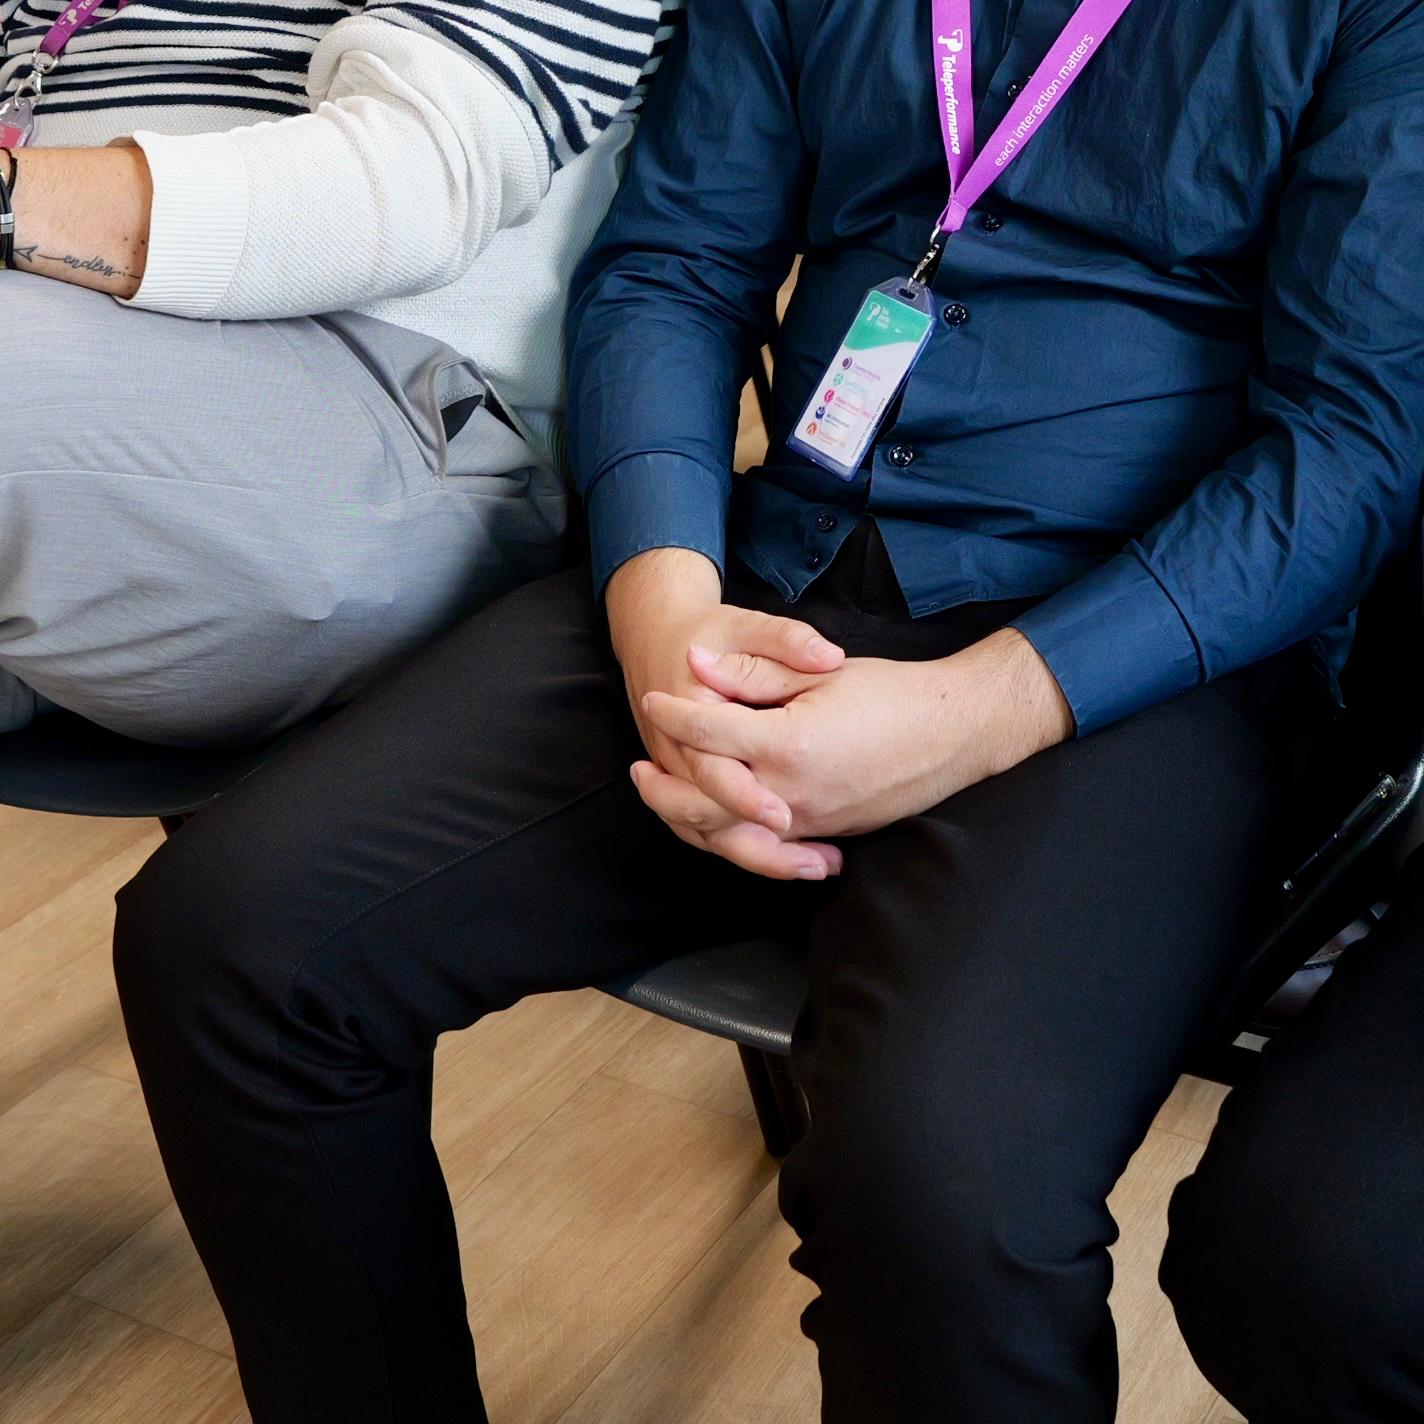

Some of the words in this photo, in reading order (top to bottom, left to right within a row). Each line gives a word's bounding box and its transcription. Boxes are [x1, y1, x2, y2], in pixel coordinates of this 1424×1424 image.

[940, 55, 961, 155] Teleperformance
[995, 136, 1019, 167] each
[1012, 78, 1064, 139] interaction
[1058, 33, 1095, 80] matters
